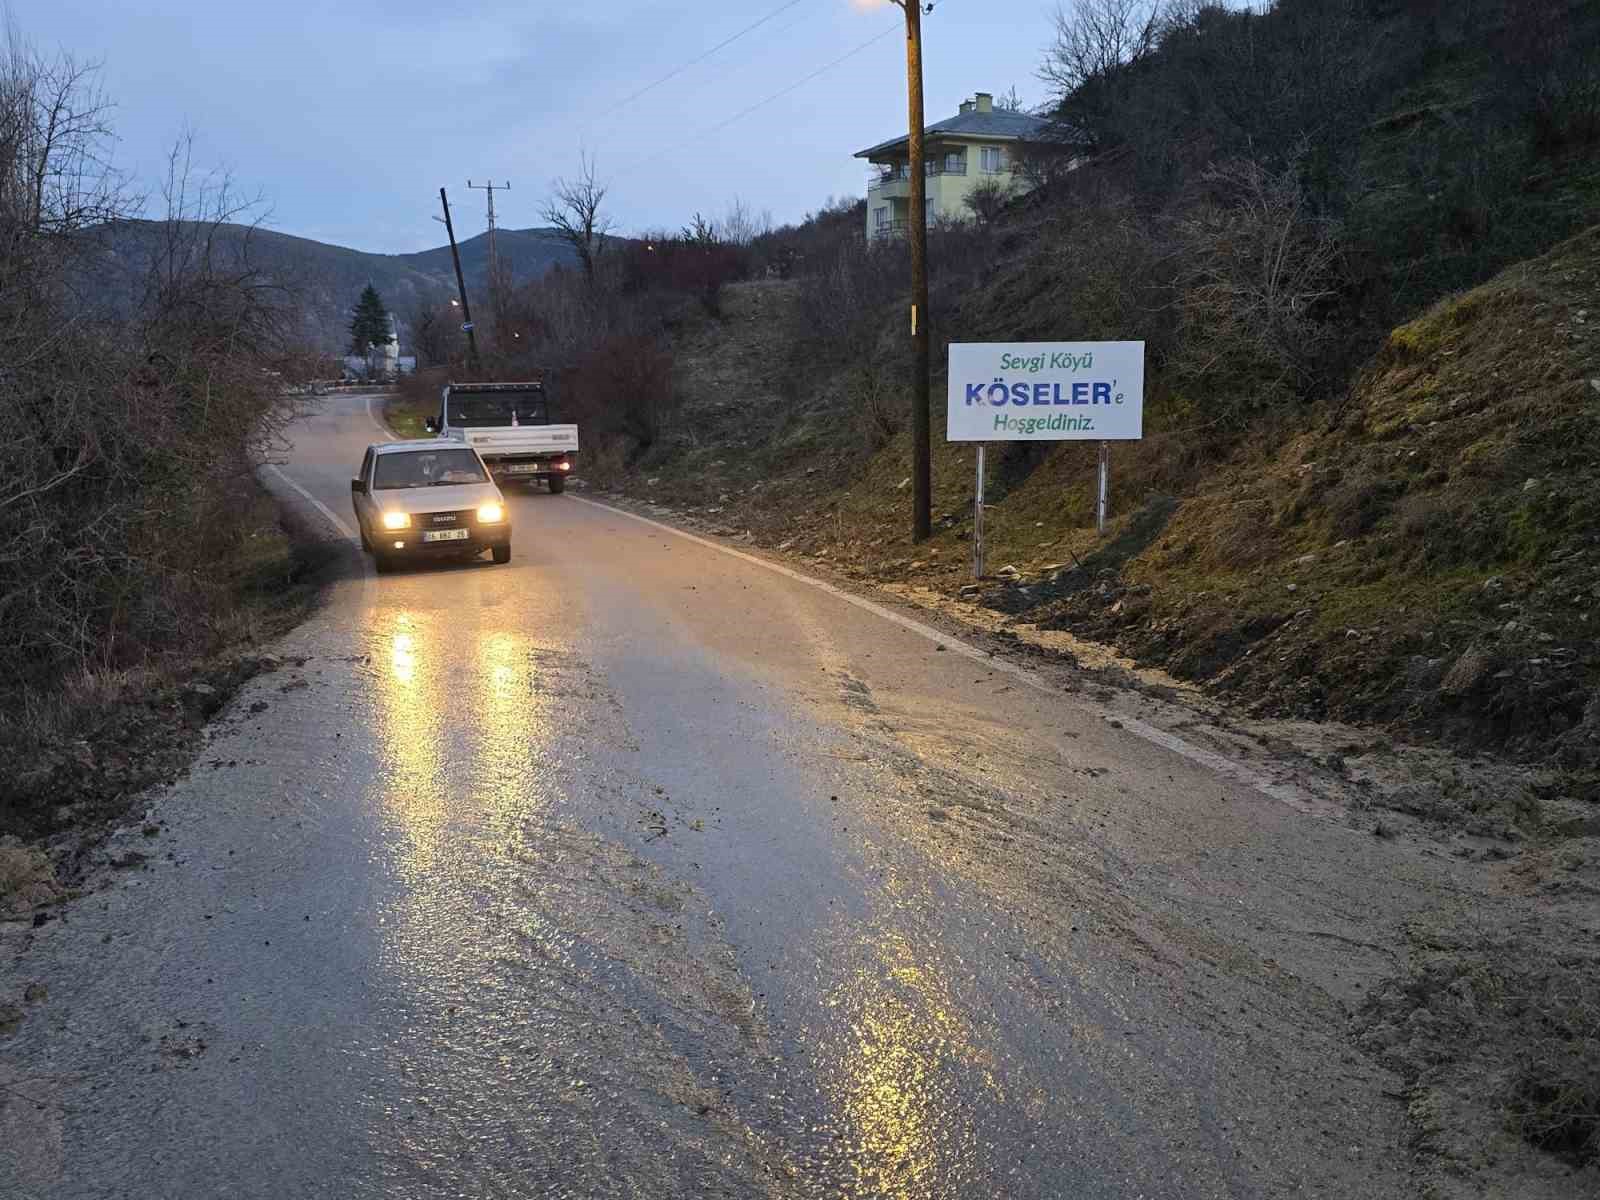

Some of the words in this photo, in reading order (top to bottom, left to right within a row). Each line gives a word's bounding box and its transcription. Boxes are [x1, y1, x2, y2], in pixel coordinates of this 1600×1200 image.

[1000, 353, 1045, 373] Sevgi
[1050, 352, 1093, 372] Köyü
[994, 414, 1095, 434] Hoşgeldiniz.
